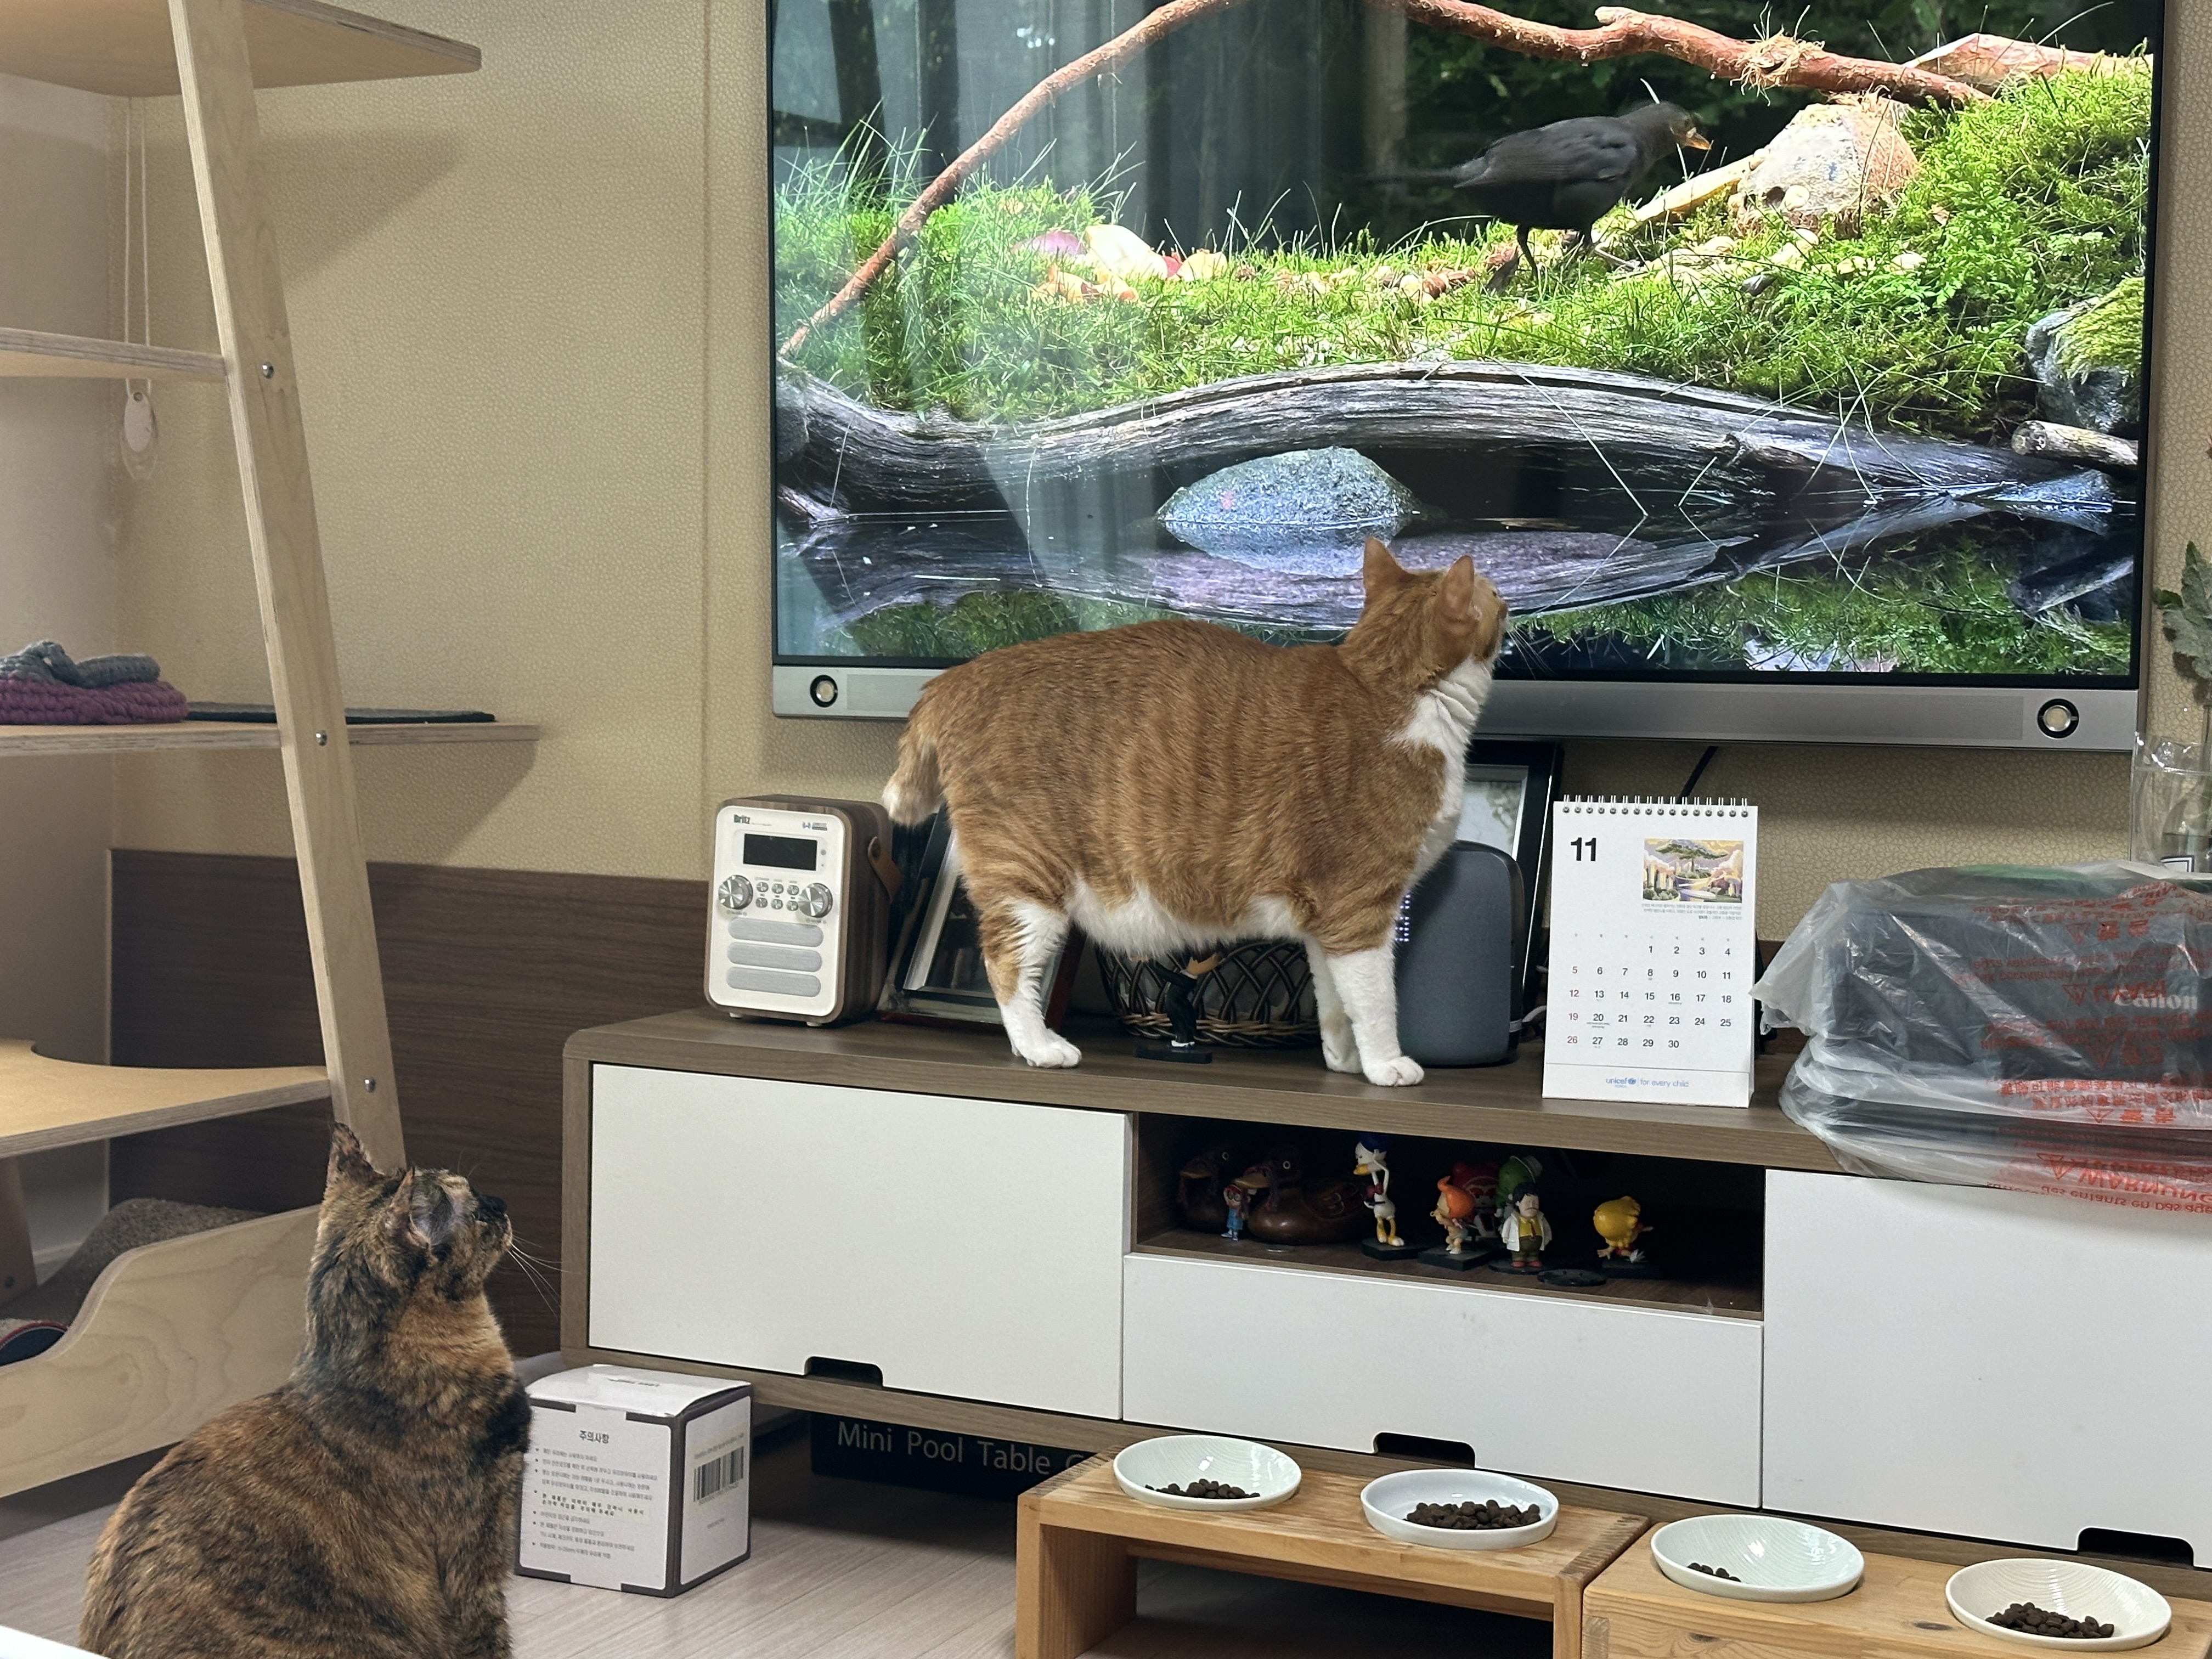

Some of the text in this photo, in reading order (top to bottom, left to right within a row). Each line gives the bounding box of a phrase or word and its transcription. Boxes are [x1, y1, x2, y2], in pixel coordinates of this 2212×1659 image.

[733, 814, 751, 825] Britz
[1570, 837, 1597, 862] 11
[1649, 945, 1731, 956] 1 2 3 4
[1572, 966, 1731, 980] 5 6 7 8 9 10 11
[1569, 989, 1732, 1003] 12 13 14 15 16 17 18
[2114, 989, 2198, 1010] Canon
[1568, 1012, 1731, 1027] 19 20 21 22 23 24 25
[1567, 1035, 1679, 1048] 26 27 28 29 30
[1651, 1079, 1671, 1088] every
[579, 1430, 610, 1444] 주의사항
[837, 1420, 893, 1453] Mini
[907, 1430, 964, 1464] Pool
[977, 1440, 1051, 1476] Table
